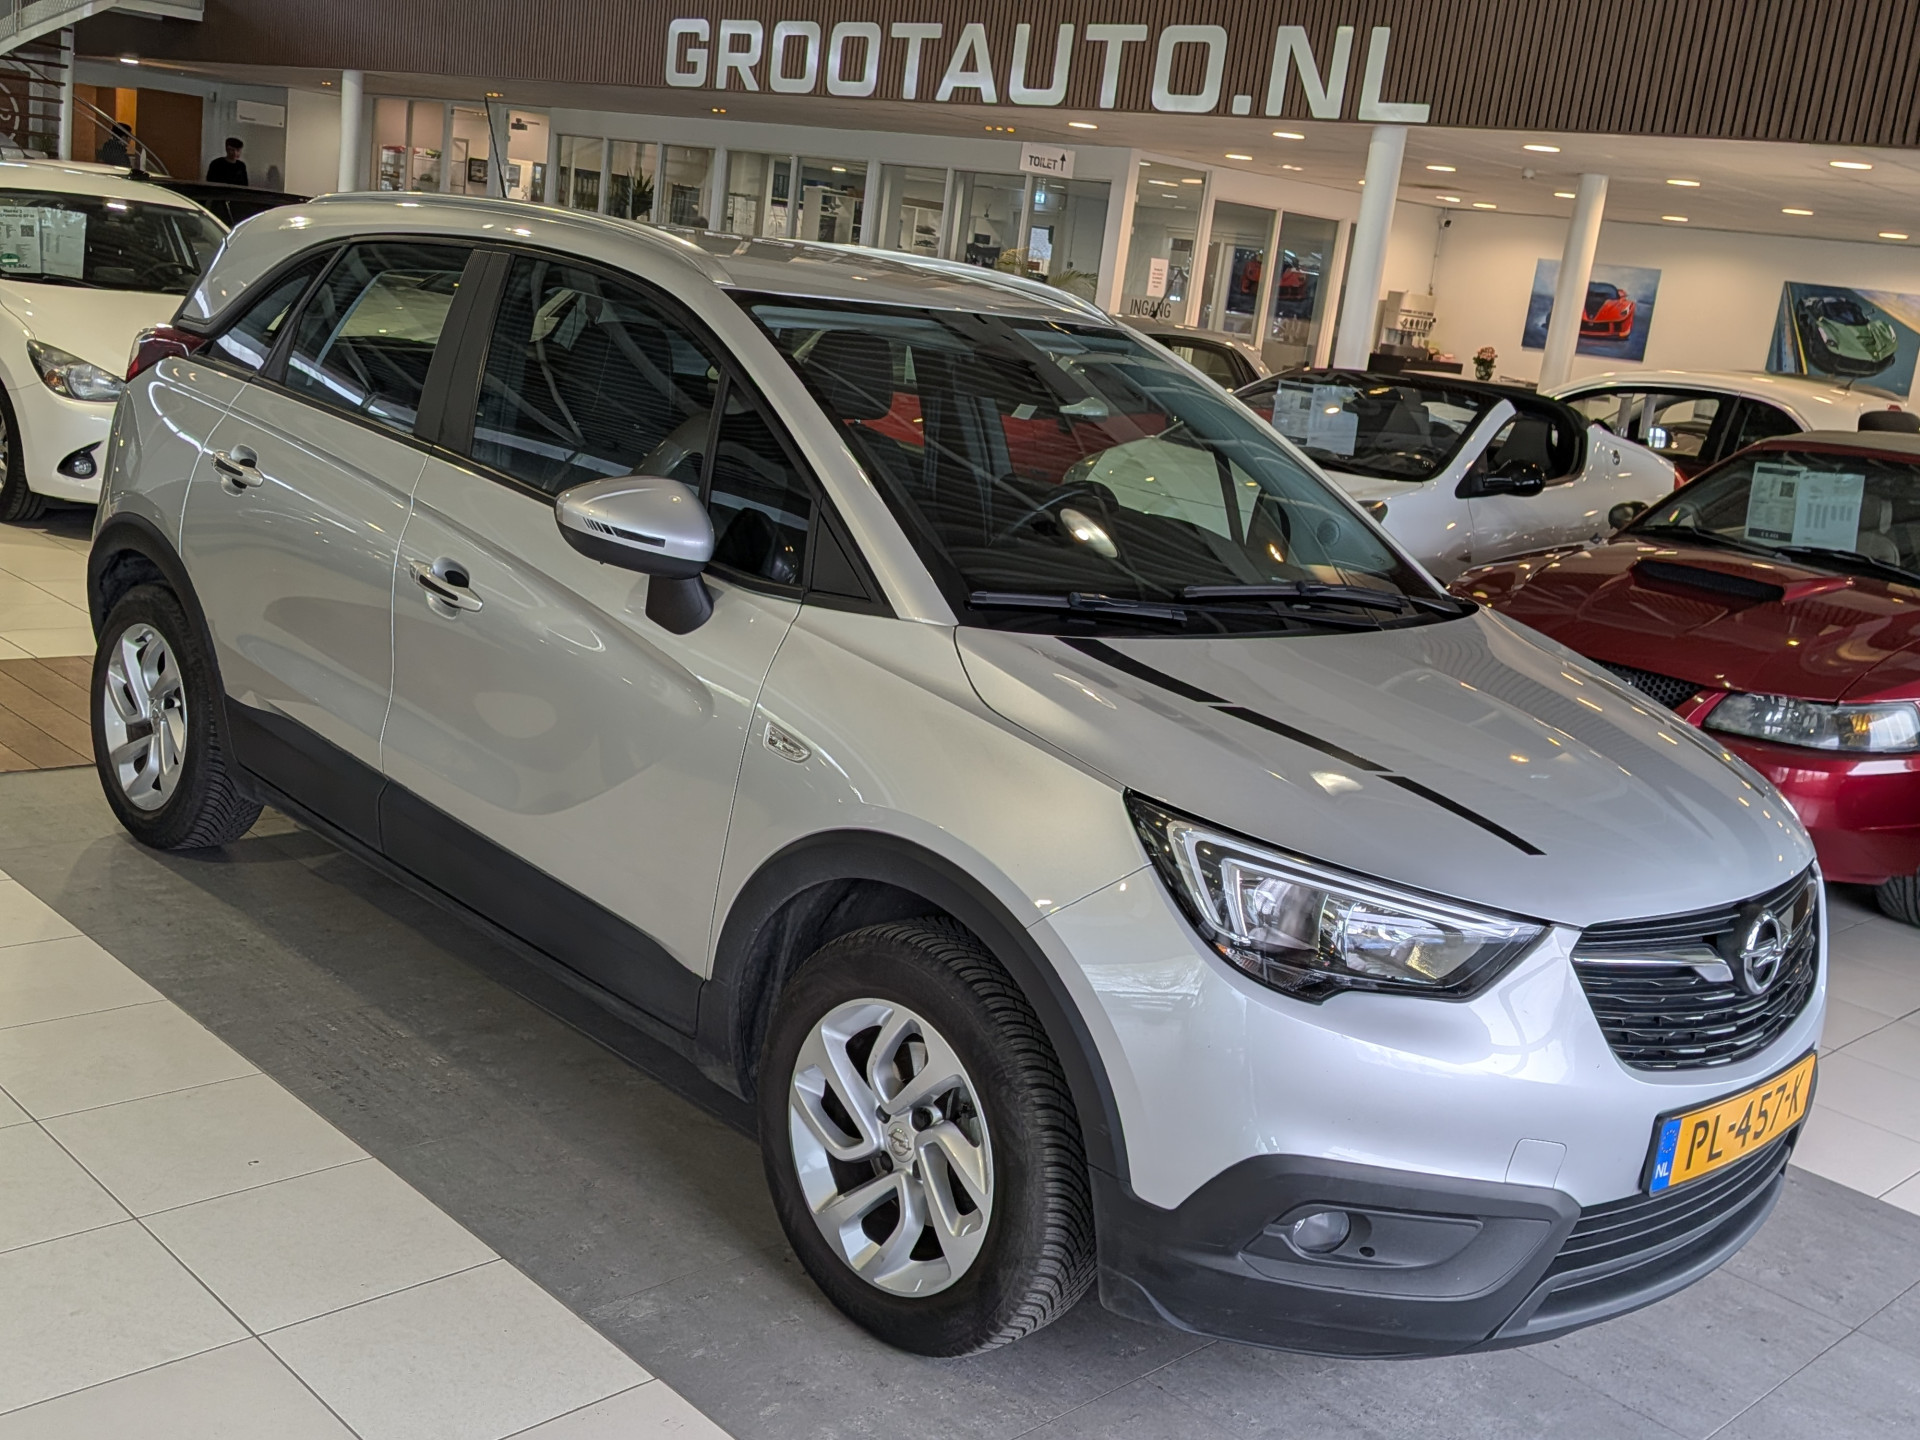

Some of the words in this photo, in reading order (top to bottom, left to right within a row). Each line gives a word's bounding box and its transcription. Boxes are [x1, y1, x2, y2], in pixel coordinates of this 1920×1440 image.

[665, 18, 1430, 123] GROOTAUTO.NL
[1028, 154, 1059, 171] TOILET
[1129, 298, 1172, 319] INGANG
[1685, 1069, 1806, 1171] PL-457-K
[1655, 1161, 1669, 1179] NL
